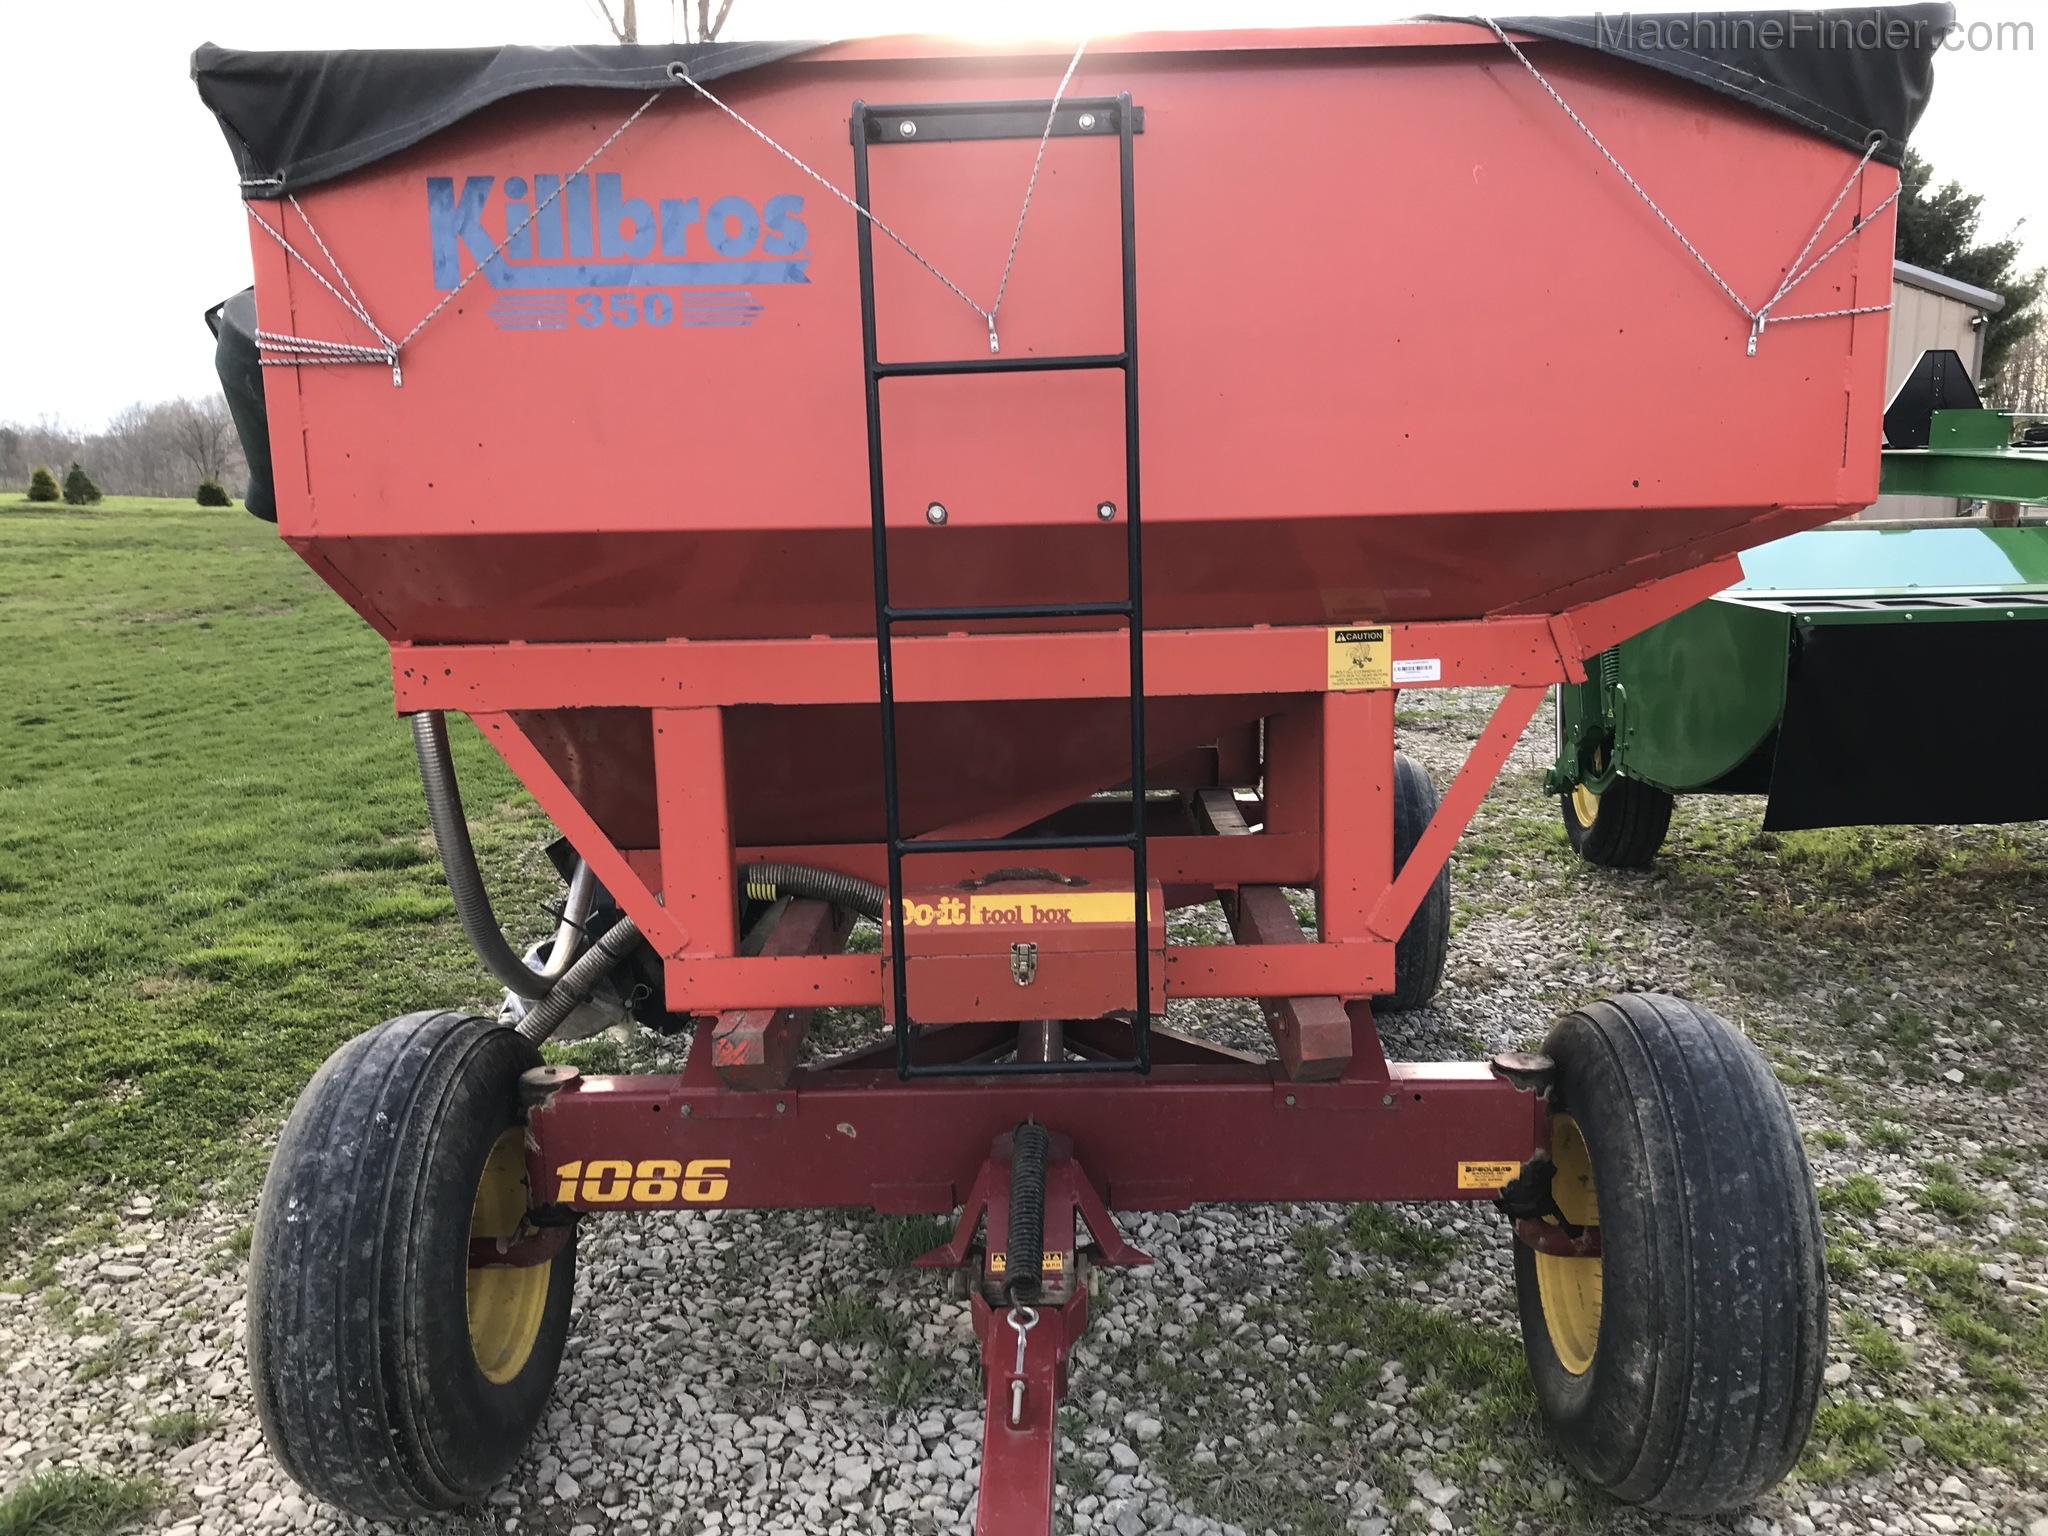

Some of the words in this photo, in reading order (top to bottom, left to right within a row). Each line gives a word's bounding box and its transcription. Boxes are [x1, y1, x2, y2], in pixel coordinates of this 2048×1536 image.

[427, 173, 808, 289] Killbros
[575, 292, 674, 328] 350
[1346, 632, 1382, 640] CAUTION
[980, 905, 1023, 923] tool
[1031, 905, 1072, 923] box
[556, 1159, 731, 1202] 1086
